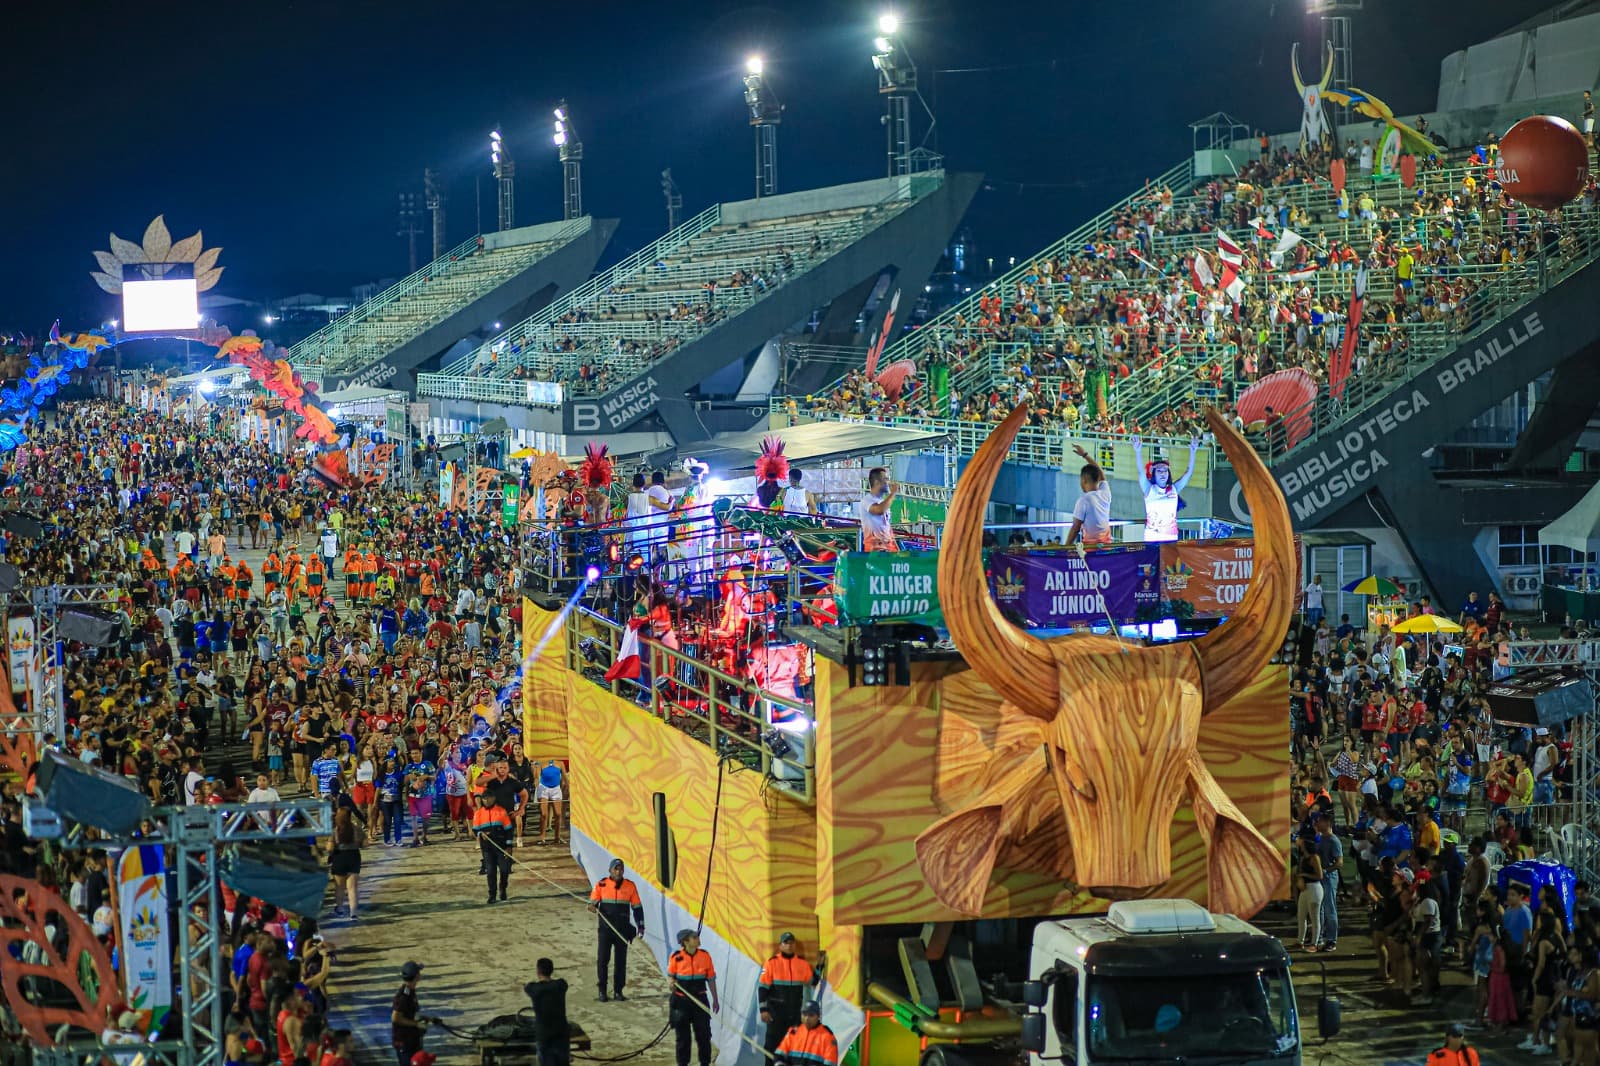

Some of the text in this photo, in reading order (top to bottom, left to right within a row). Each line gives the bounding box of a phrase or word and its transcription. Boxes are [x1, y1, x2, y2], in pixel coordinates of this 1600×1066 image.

[609, 392, 660, 428] DANÇA
[1280, 312, 1544, 497] BIBLIOTECA BRAILLE
[573, 404, 600, 431] B
[1292, 449, 1389, 521] MÚSICA
[1067, 559, 1085, 569] TRIO
[1234, 548, 1252, 558] TRIO
[891, 562, 910, 573] TRIO
[869, 575, 932, 595] KLINGER
[1044, 570, 1110, 591] ARLINDO
[1049, 591, 1106, 615] JÚNIOR
